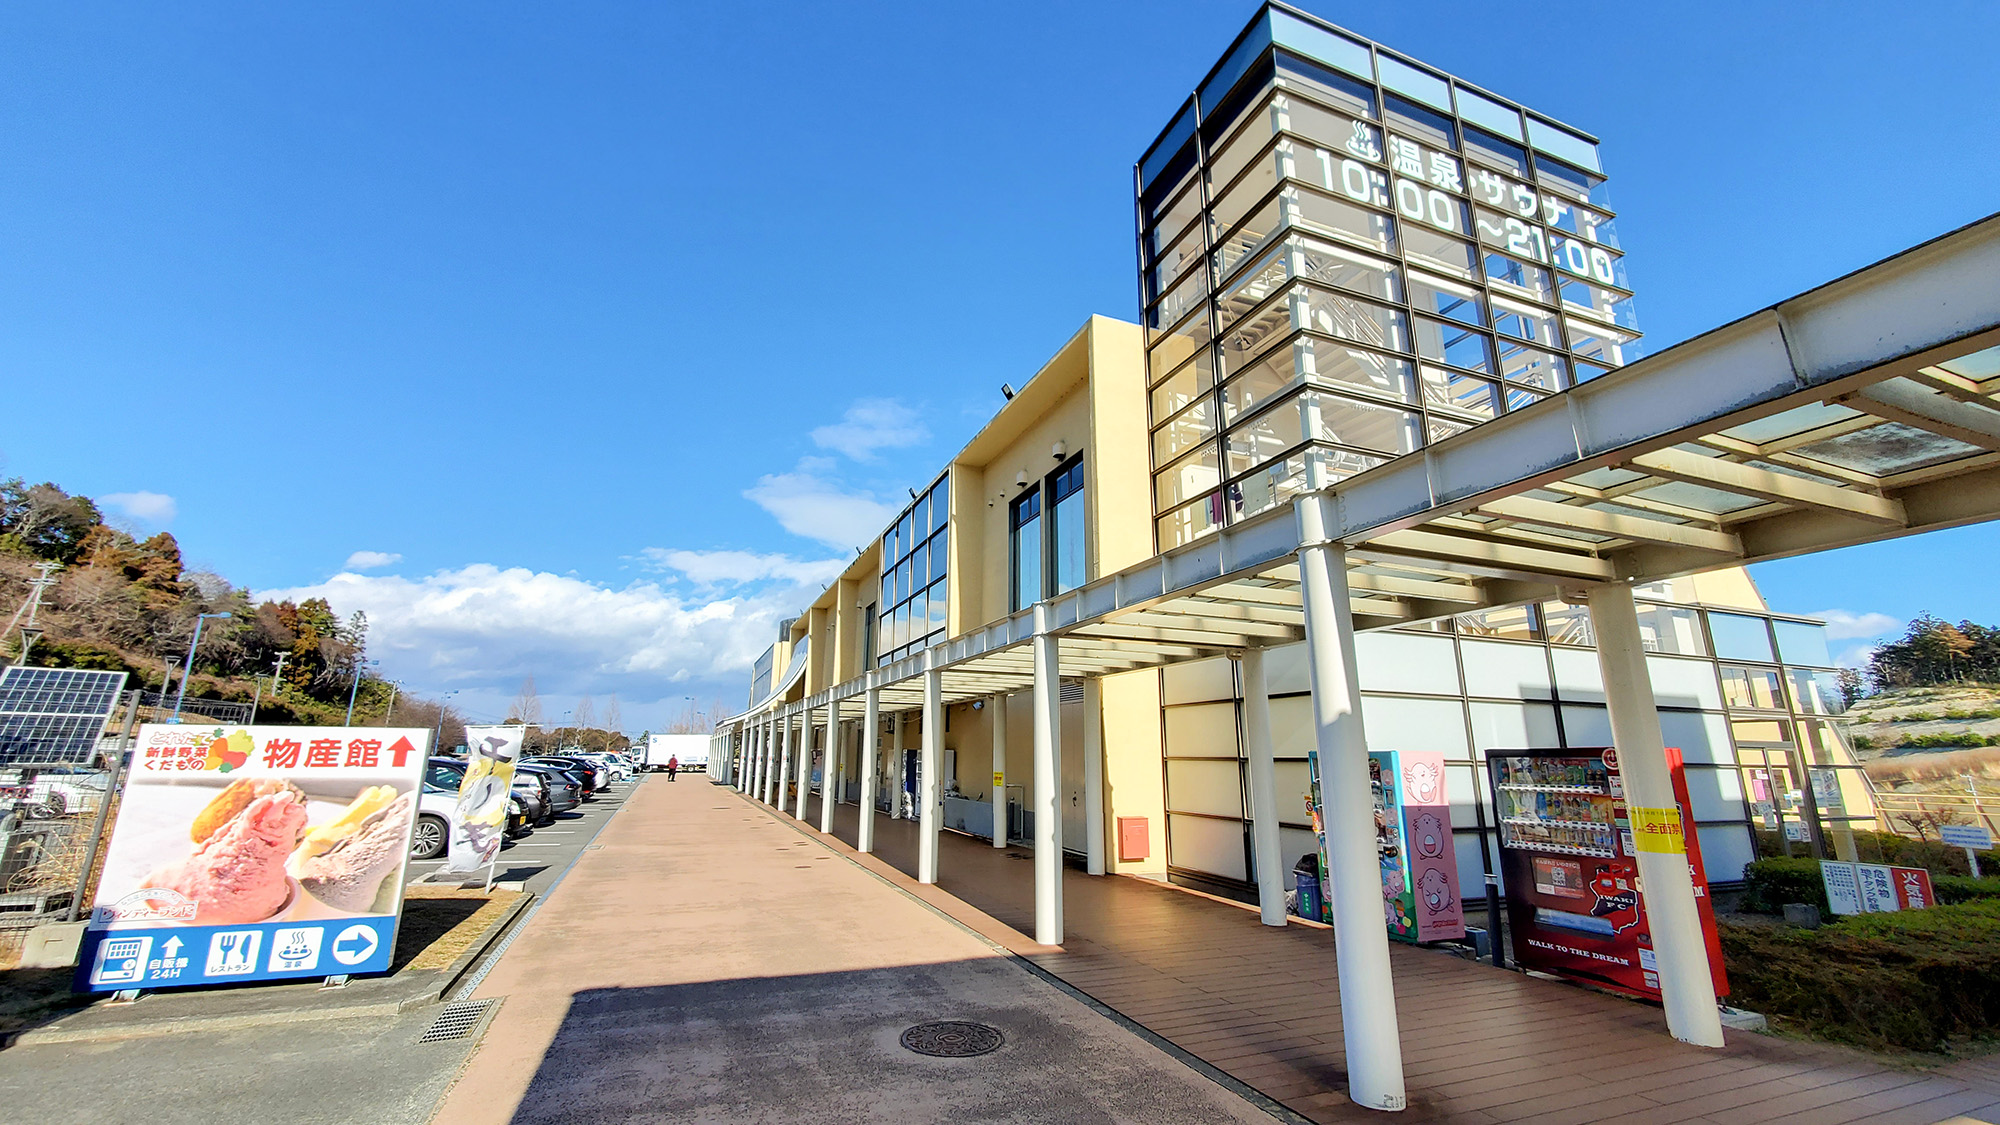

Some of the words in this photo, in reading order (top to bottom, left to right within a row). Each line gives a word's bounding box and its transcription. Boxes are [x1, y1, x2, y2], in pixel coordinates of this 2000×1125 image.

[149, 731, 215, 746] とれたて
[145, 747, 208, 758] 新鮮野菜
[262, 738, 382, 769] 物産館
[144, 760, 205, 771] くだもの
[1600, 894, 1634, 904] IWAKI
[1528, 938, 1555, 950] WALK
[1556, 944, 1569, 953] TO
[1569, 947, 1590, 958] THE
[1592, 952, 1630, 967] DREAM
[149, 957, 189, 970] 自販機
[210, 964, 250, 973] レストラン
[283, 961, 303, 969] 温泉
[150, 968, 182, 980] 24H
